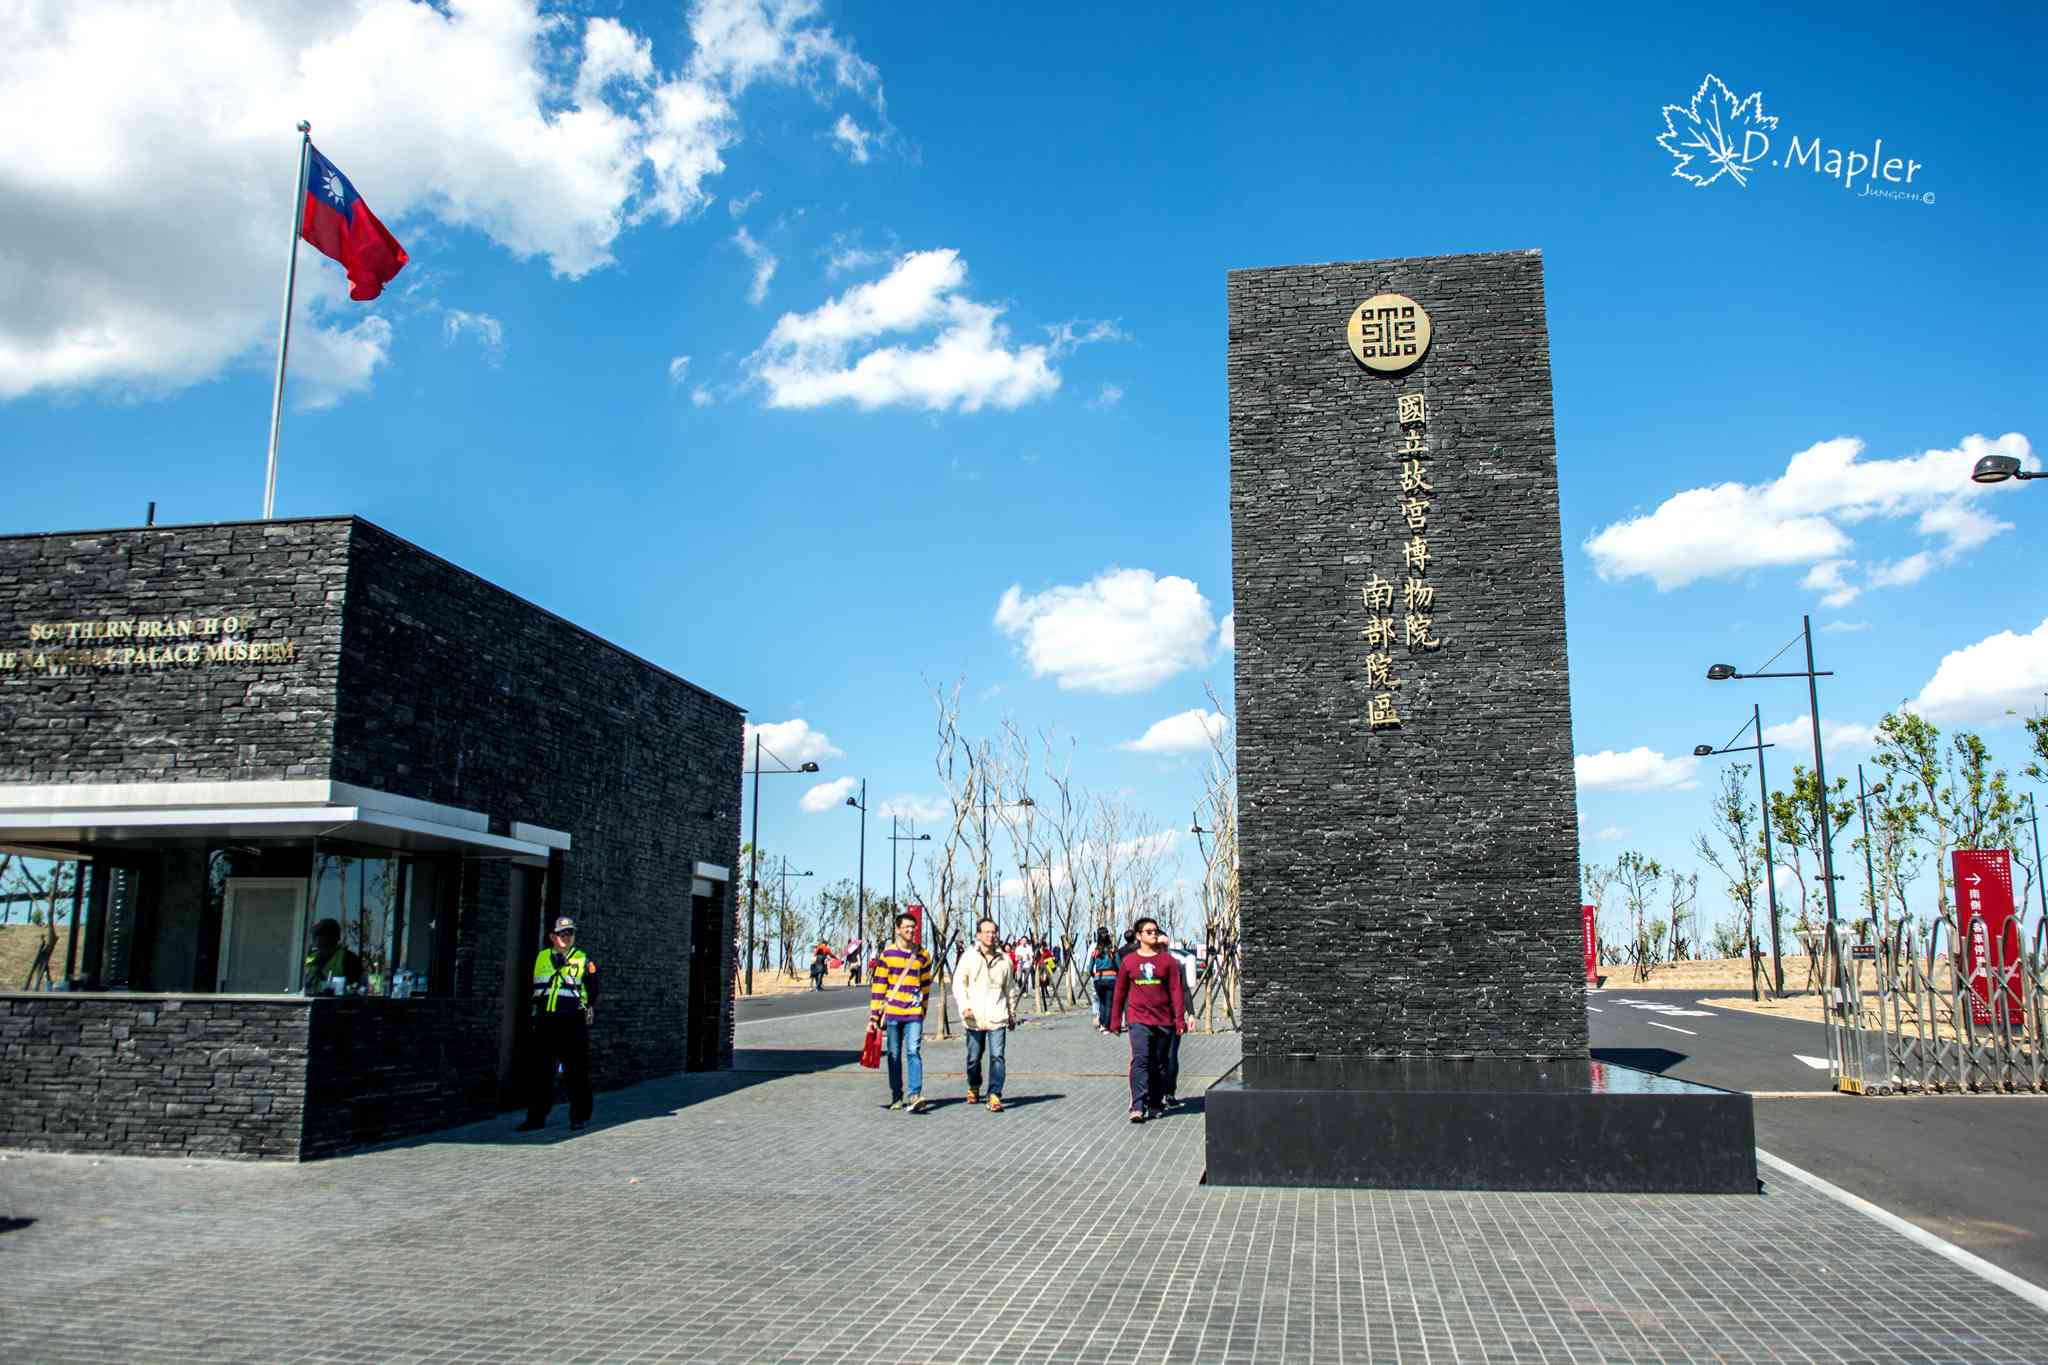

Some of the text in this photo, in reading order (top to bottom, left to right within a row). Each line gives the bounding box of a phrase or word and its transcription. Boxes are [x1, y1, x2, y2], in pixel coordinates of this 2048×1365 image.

[1398, 393, 1440, 647] 國立故宮博物院
[122, 645, 200, 665] PALACE
[206, 640, 295, 662] MUSEUM
[137, 617, 219, 638] BRANCH
[223, 615, 249, 635] OF
[1362, 574, 1401, 729] 南部院區
